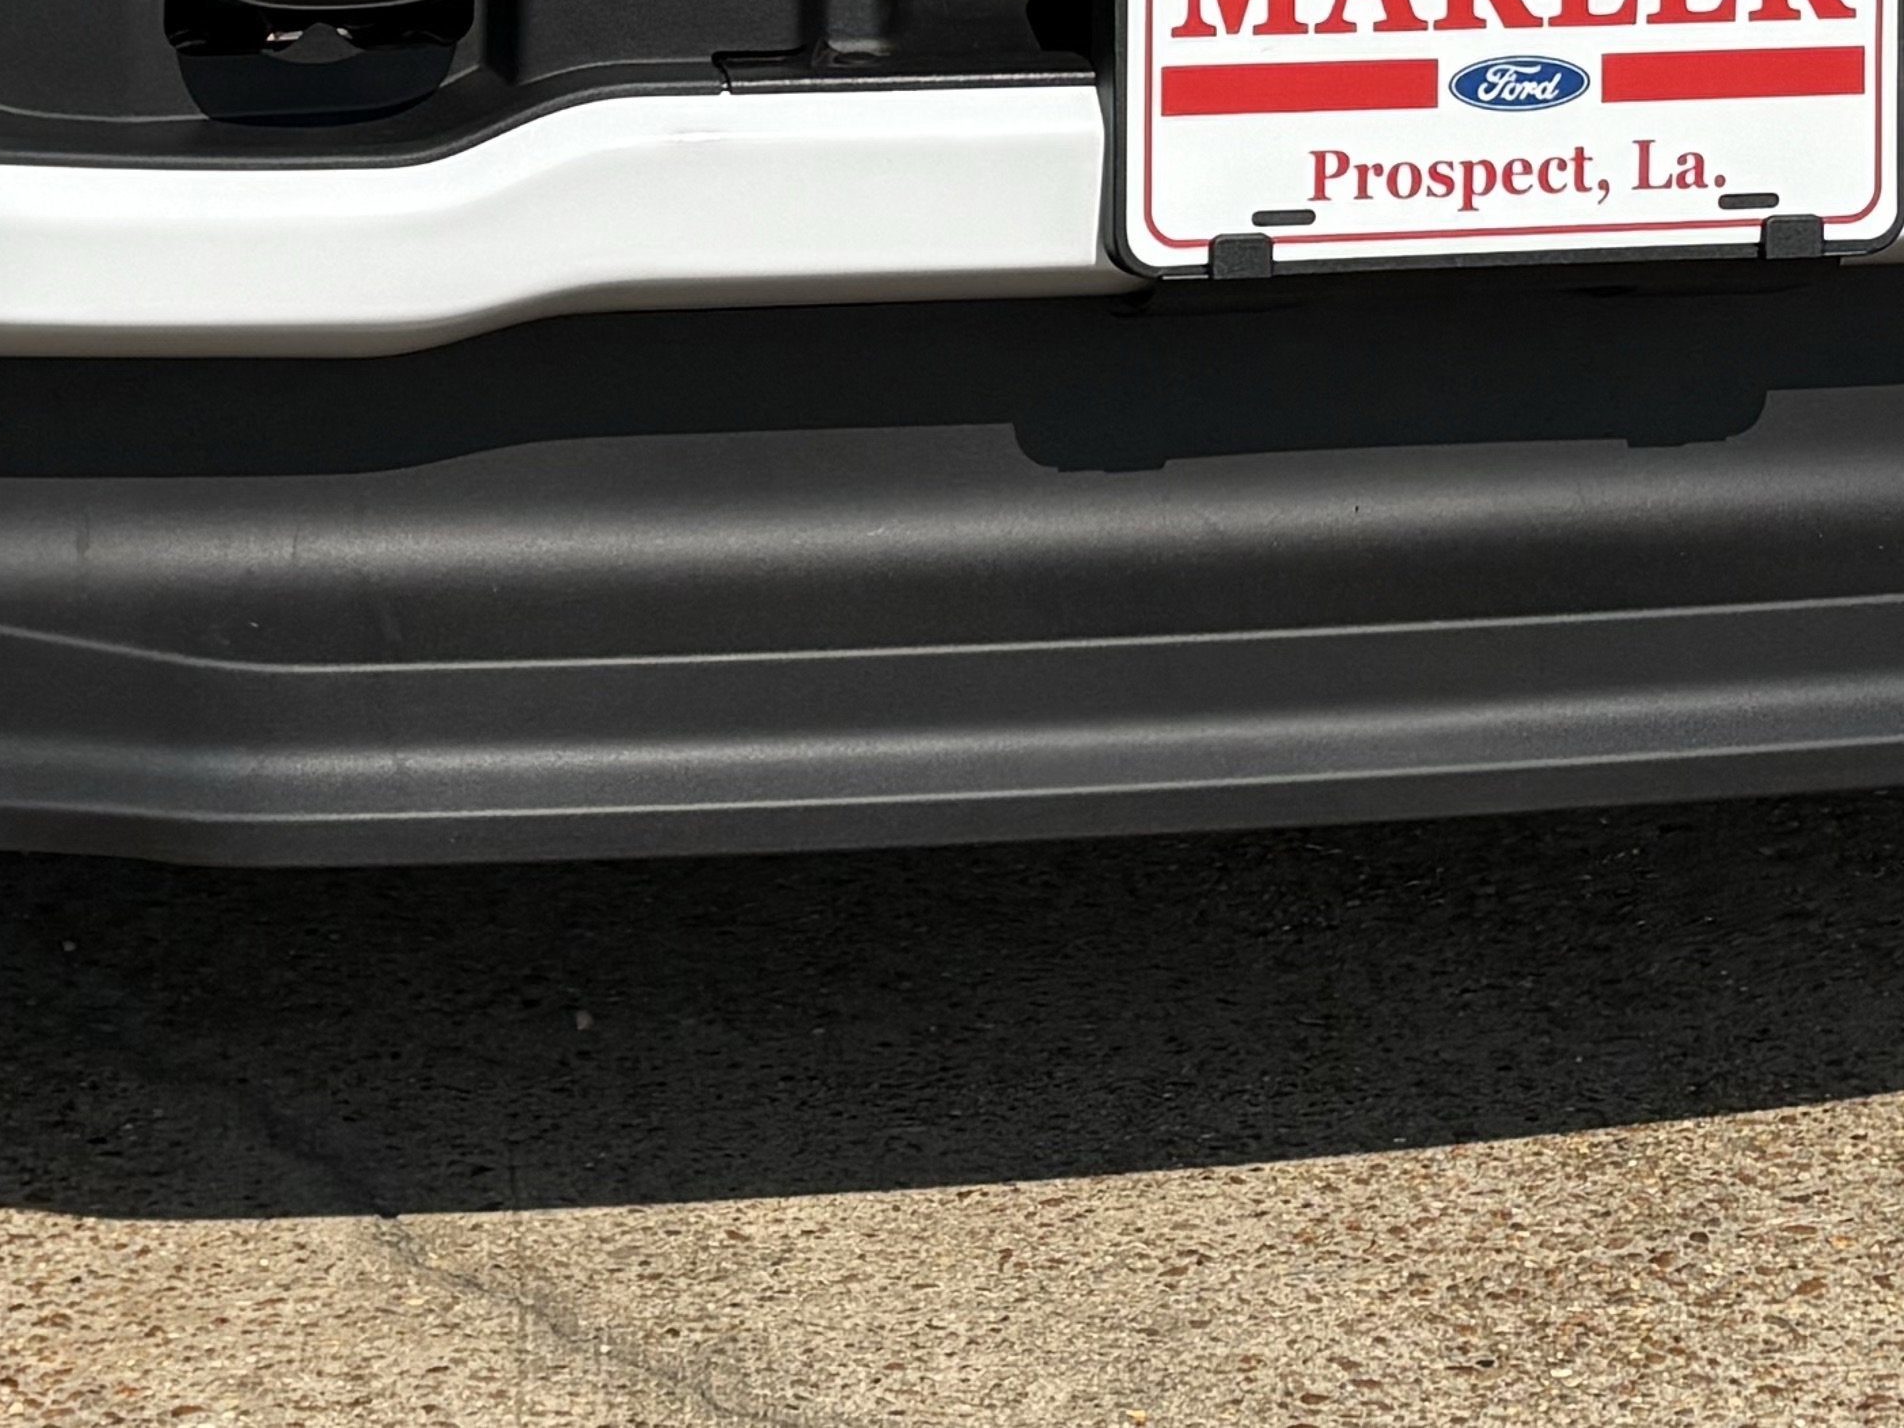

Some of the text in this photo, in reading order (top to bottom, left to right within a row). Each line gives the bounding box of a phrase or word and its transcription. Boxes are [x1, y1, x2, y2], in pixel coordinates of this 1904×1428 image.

[1477, 64, 1562, 101] Ford
[1308, 139, 1727, 212] Prospect, La.
